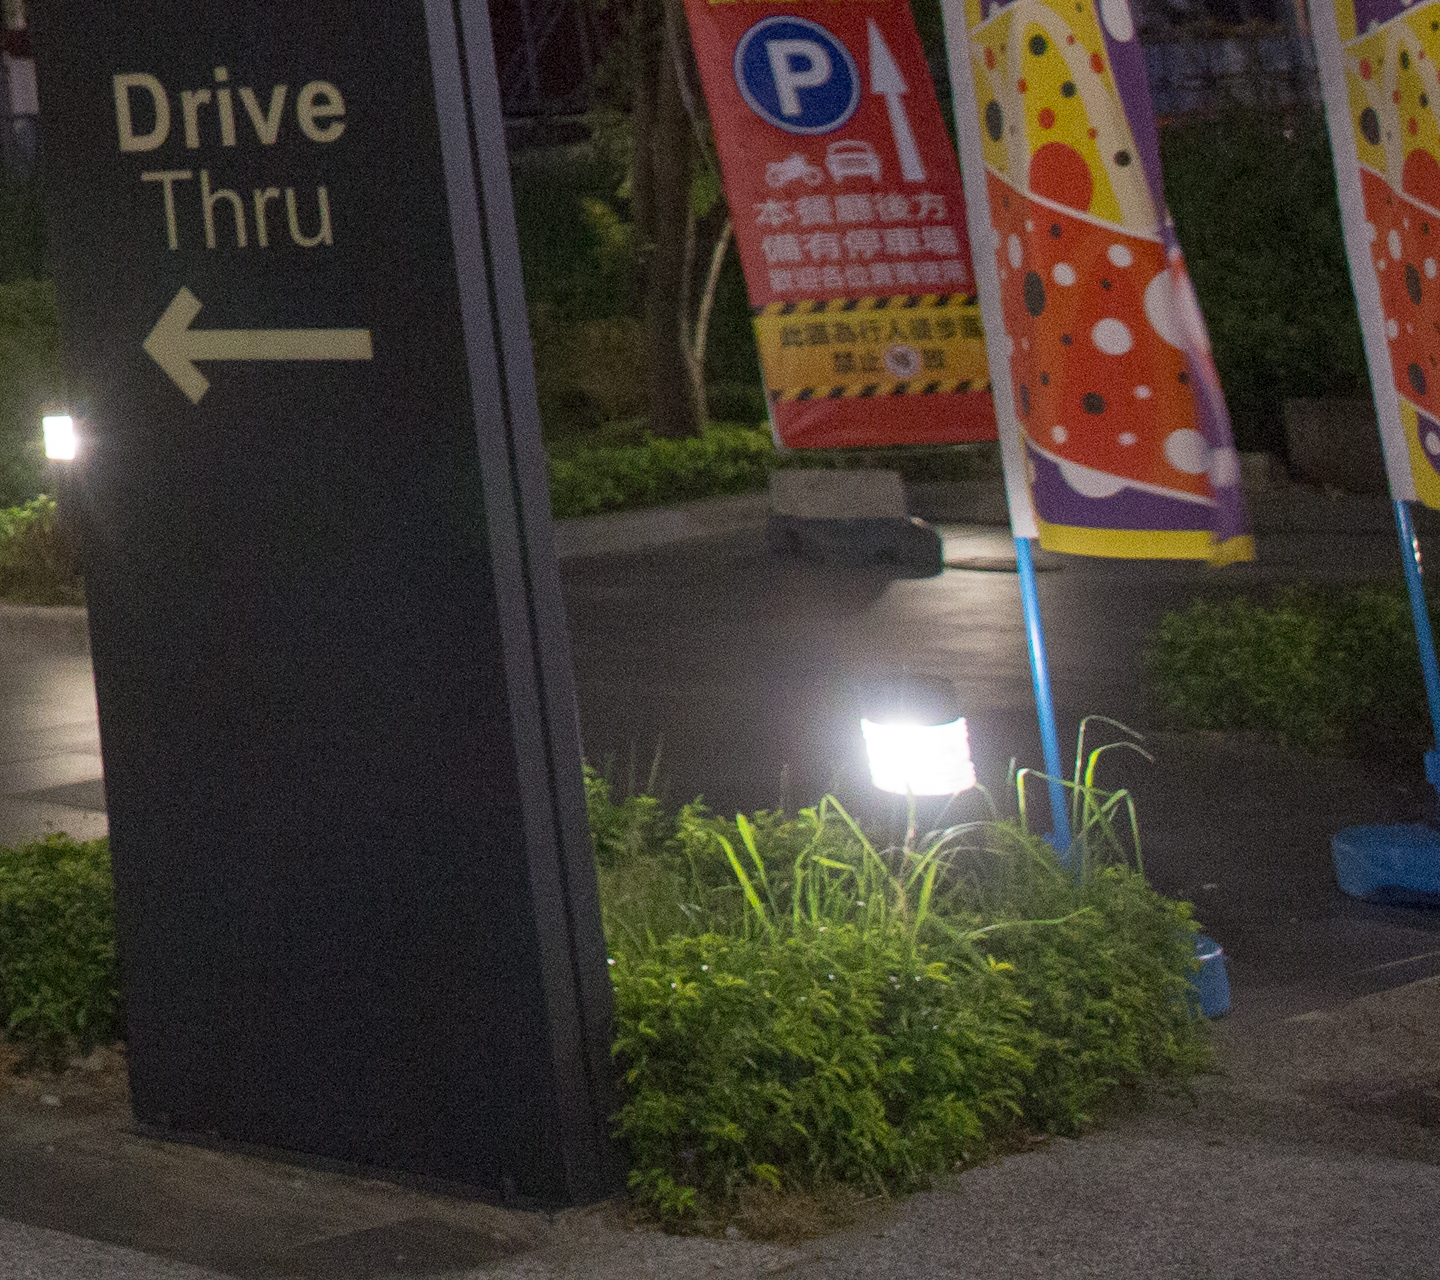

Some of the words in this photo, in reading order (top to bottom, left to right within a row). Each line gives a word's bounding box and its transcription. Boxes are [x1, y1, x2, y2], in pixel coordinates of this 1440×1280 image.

[112, 66, 347, 153] Drive
[765, 38, 832, 118] P
[140, 170, 334, 251] Thru
